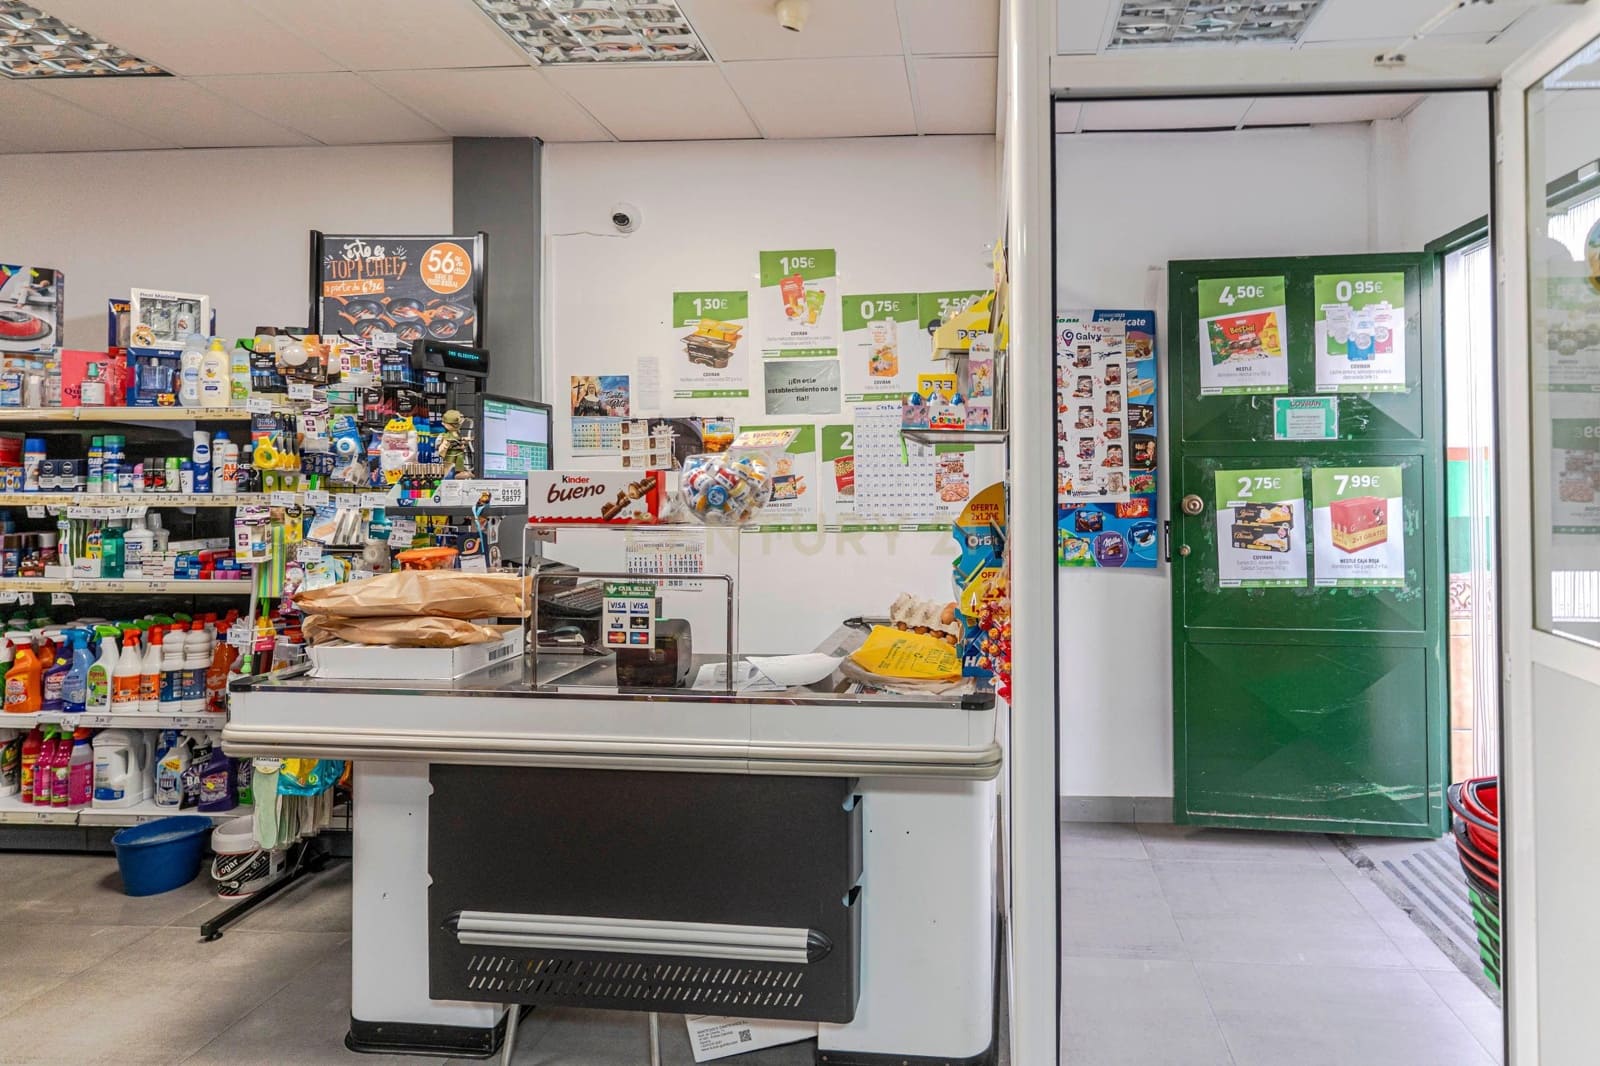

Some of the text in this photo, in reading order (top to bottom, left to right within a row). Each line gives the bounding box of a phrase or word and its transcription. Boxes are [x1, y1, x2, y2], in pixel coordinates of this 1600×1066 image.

[330, 260, 355, 278] TOP
[428, 250, 454, 274] 56
[780, 257, 816, 276] 1,05€
[1218, 286, 1264, 306] 4,50€
[1336, 280, 1384, 302] 0,95€
[693, 298, 728, 316] 1,30€
[860, 300, 900, 320] 0,75€
[1076, 332, 1102, 342] Galvy
[562, 474, 590, 484] Kinder
[1238, 476, 1280, 498] 2,75€
[1334, 474, 1380, 496] 7,99€
[547, 483, 606, 504] bueno
[1102, 536, 1122, 547] Milka
